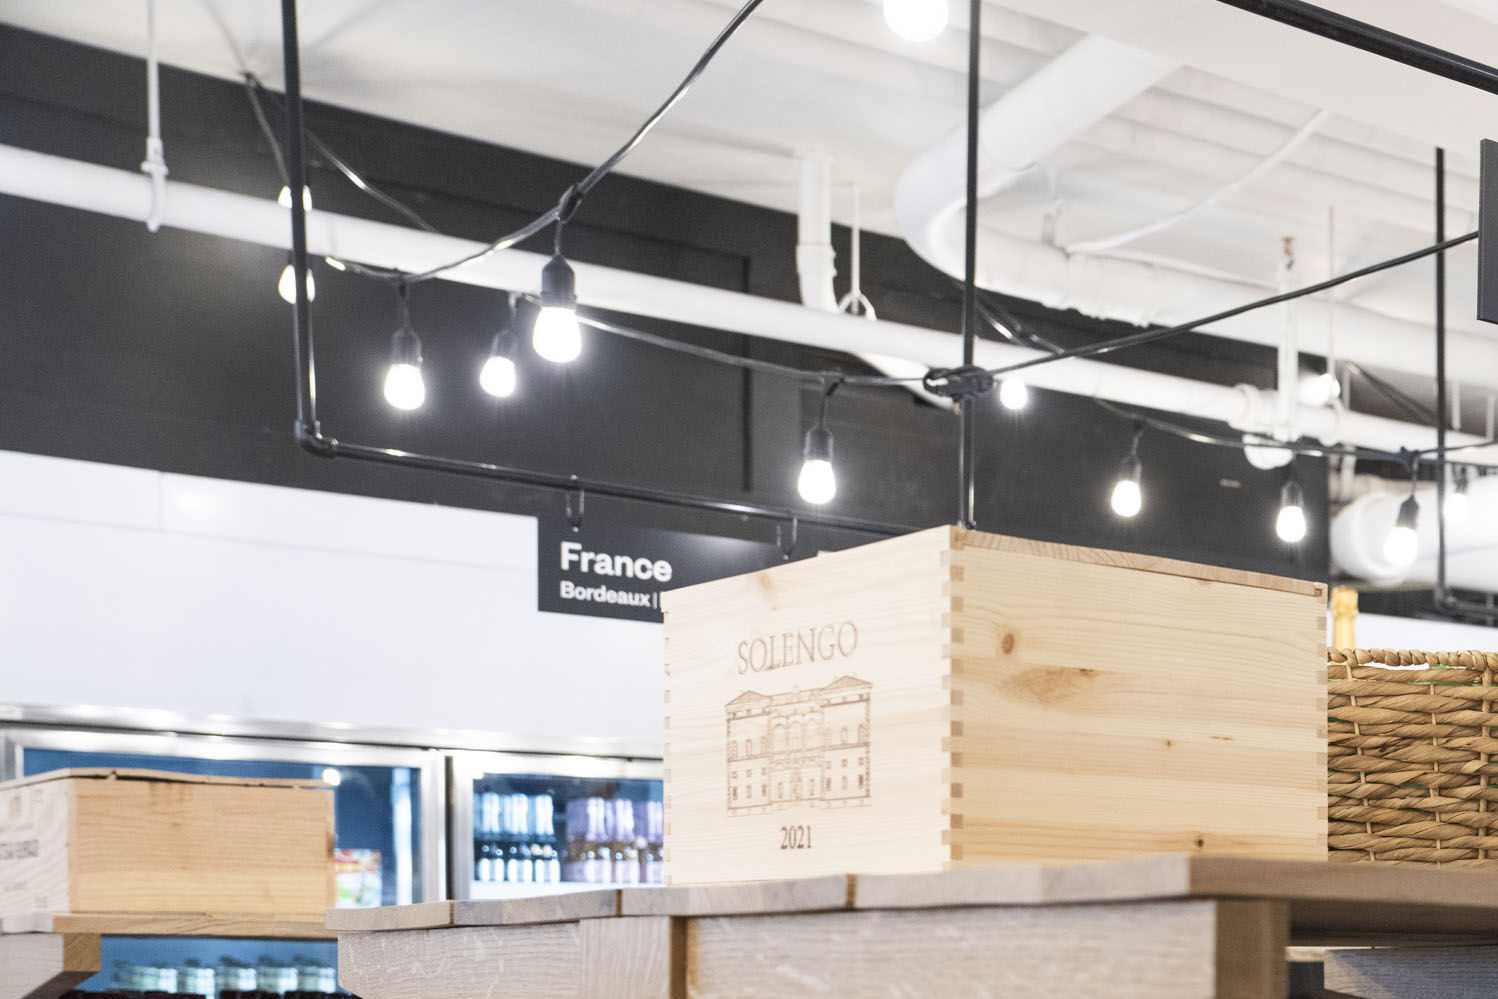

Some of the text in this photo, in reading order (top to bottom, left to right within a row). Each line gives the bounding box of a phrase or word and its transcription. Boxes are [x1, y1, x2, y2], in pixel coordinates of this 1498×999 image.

[560, 540, 673, 583] France
[559, 580, 651, 608] Bordeaux
[737, 620, 858, 675] SOLENGO
[779, 825, 814, 851] 2021
